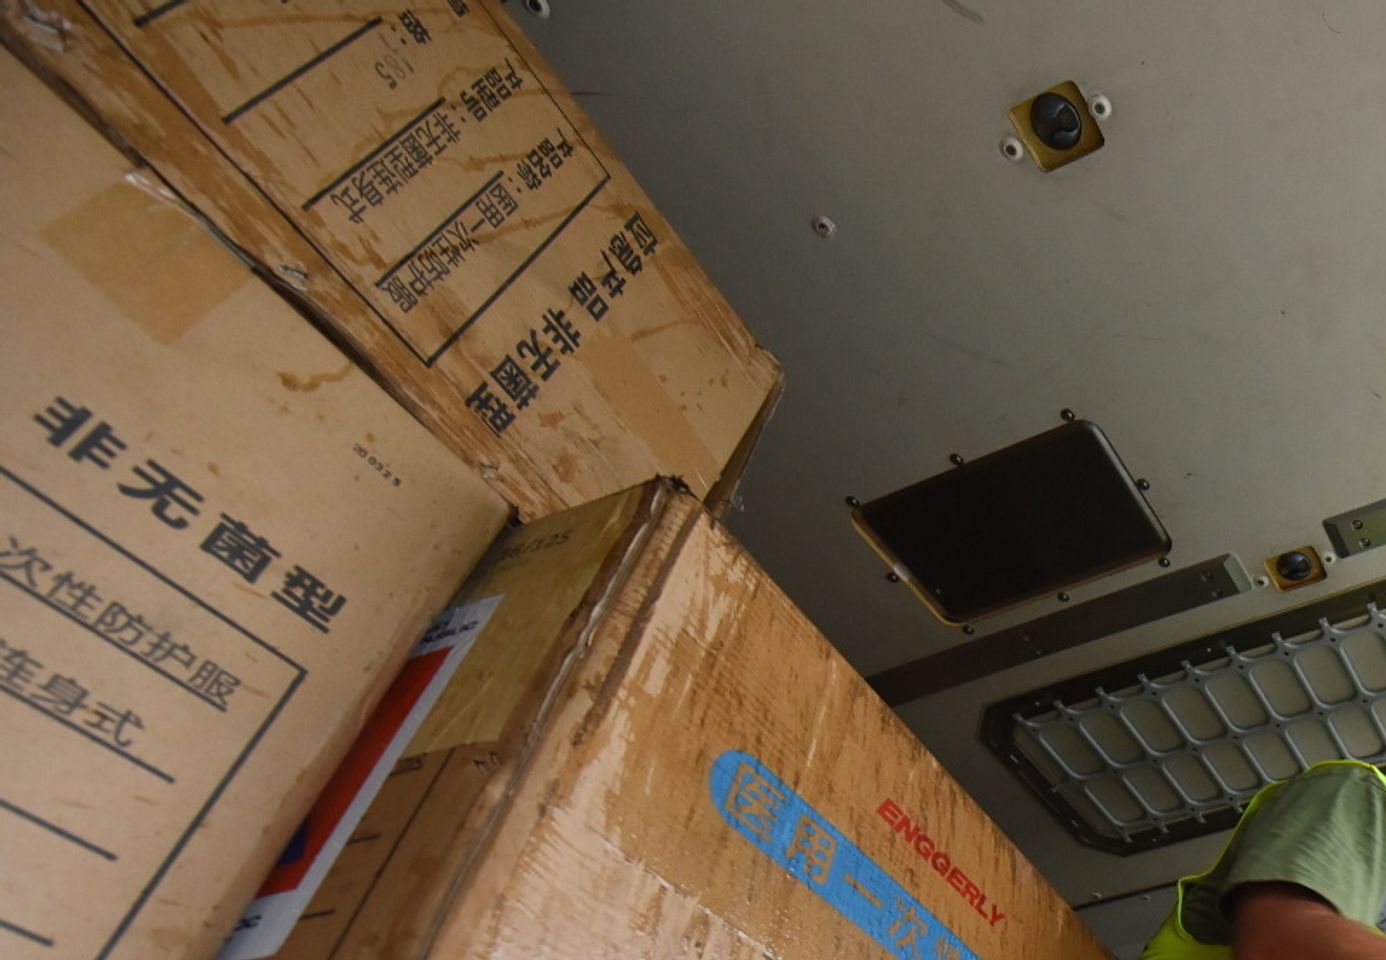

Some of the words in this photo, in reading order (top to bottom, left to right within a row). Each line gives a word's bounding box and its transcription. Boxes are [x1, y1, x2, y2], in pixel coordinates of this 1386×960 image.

[32, 396, 348, 634] 非无菌型
[875, 798, 1008, 928] ENGGERLY
